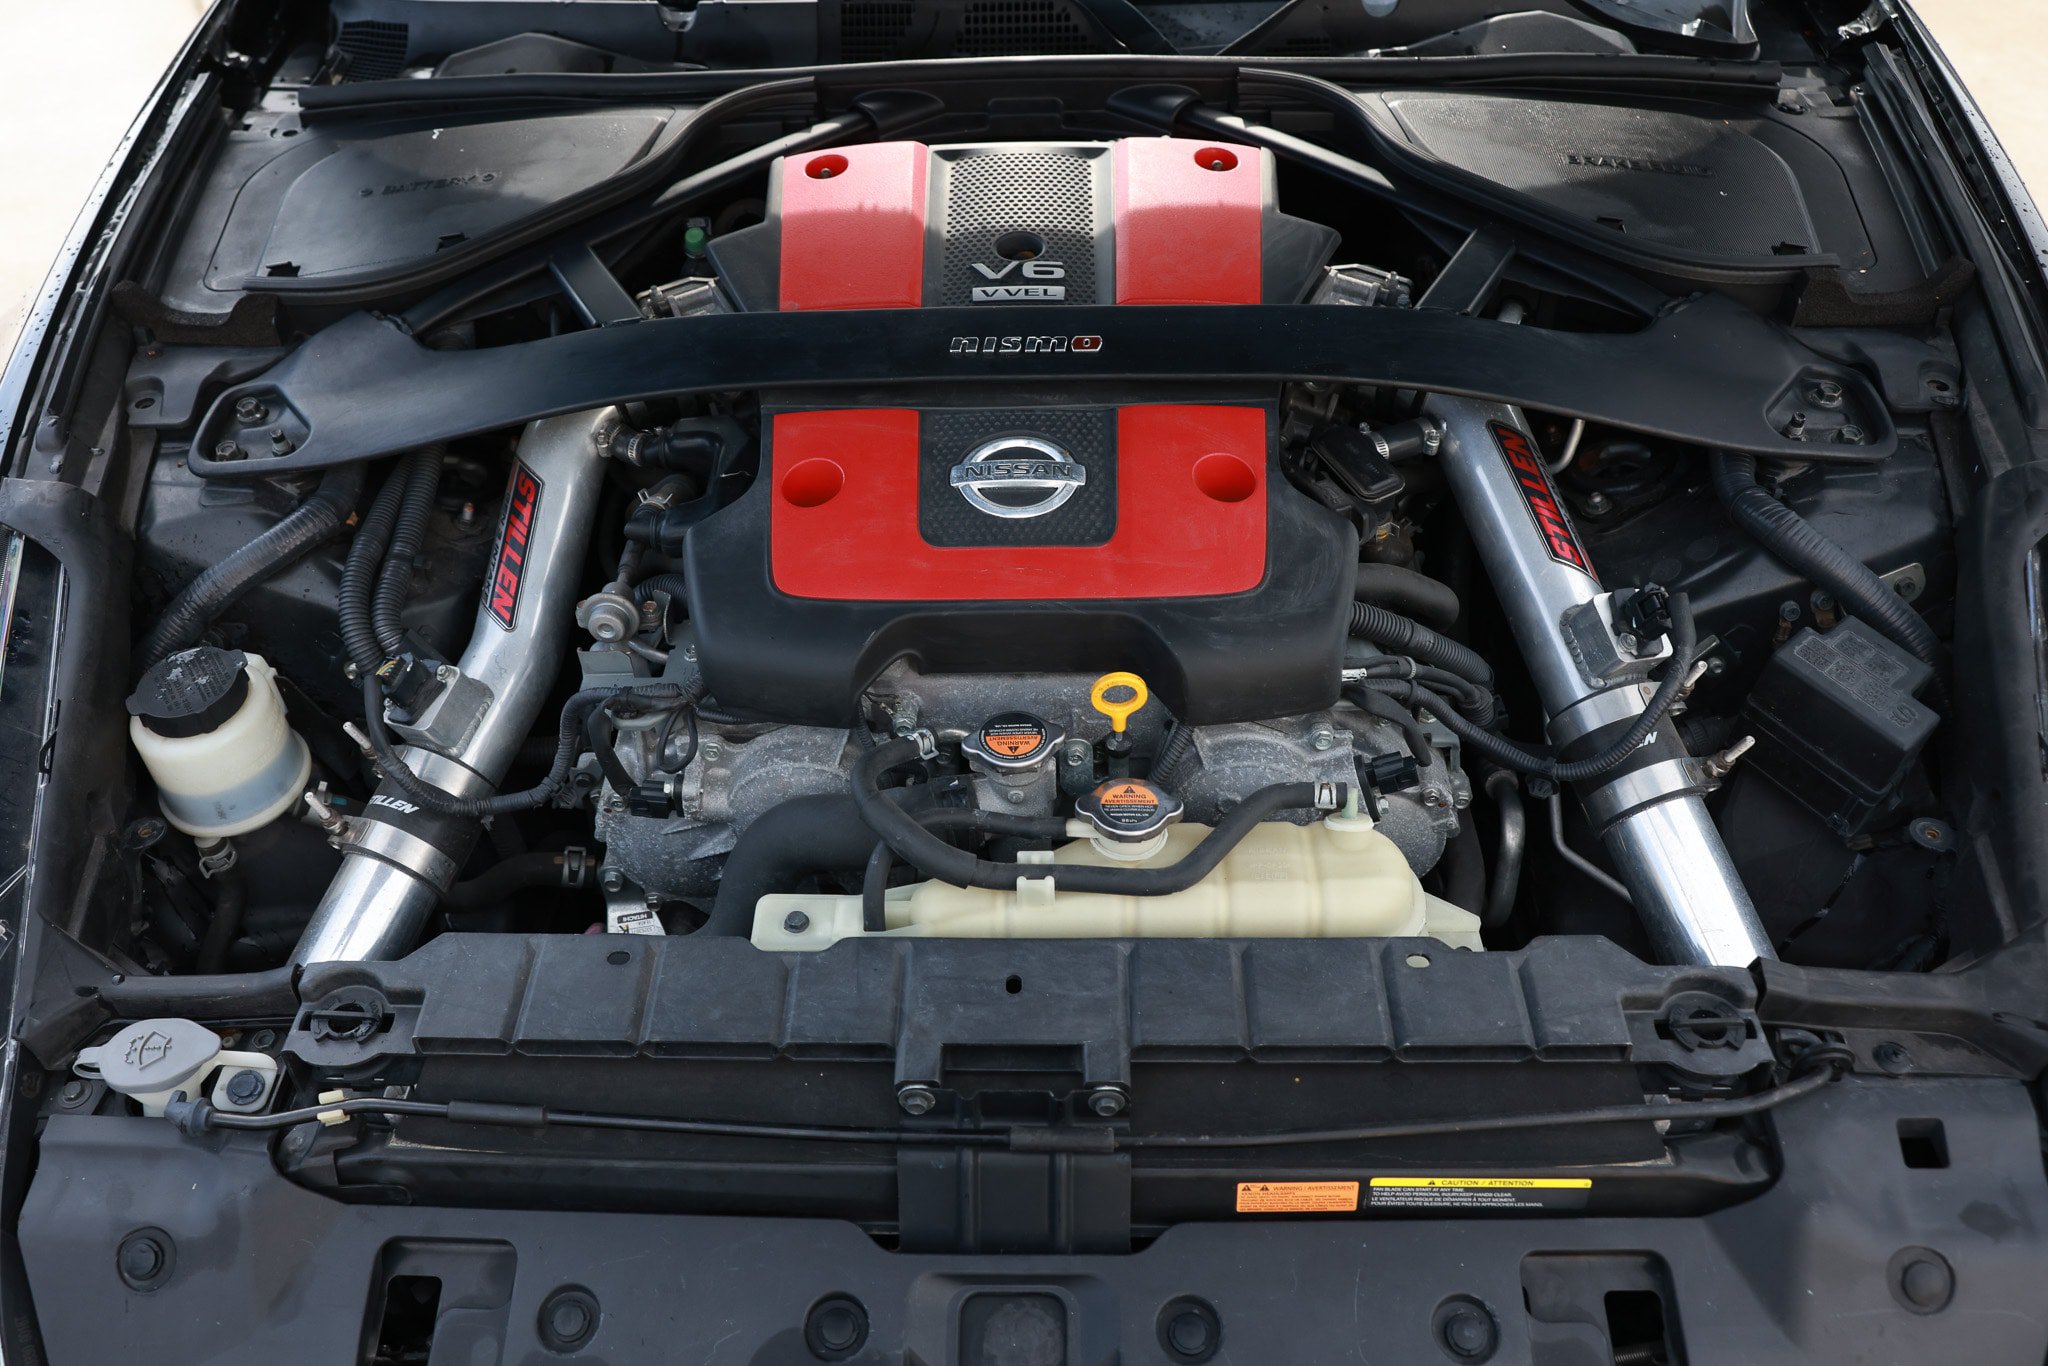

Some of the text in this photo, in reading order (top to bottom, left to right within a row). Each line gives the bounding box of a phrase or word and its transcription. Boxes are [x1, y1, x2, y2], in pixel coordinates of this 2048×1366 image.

[1560, 153, 1643, 170] BRAKE
[381, 174, 477, 196] BATTERY
[971, 261, 1066, 280] V6
[980, 288, 1057, 298] VVEL
[964, 463, 1071, 478] NISSAN
[1496, 427, 1583, 566] STILLEN
[492, 471, 536, 622] STILLEN
[370, 795, 420, 814] TILLEN
